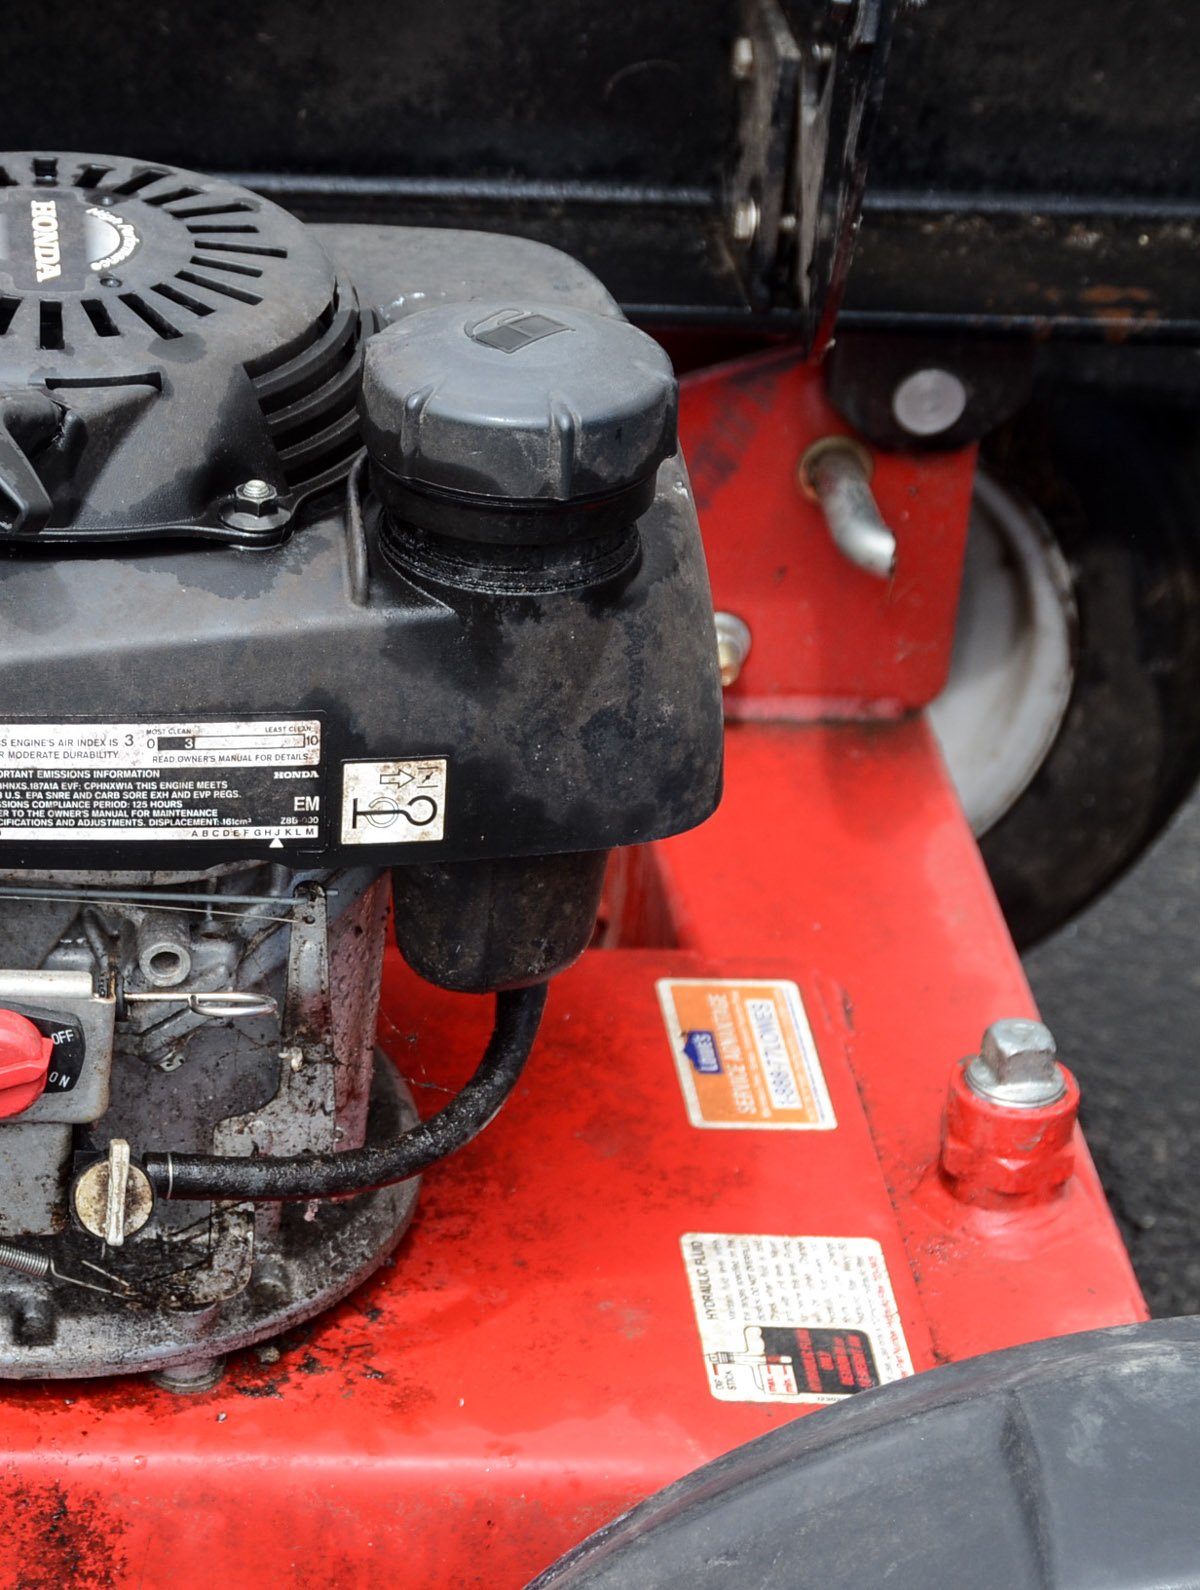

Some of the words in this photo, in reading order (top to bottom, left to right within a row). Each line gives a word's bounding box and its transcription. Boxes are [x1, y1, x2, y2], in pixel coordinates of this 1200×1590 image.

[30, 200, 62, 283] HONDA
[90, 224, 140, 271] Performance
[289, 725, 312, 733] CLEAN
[11, 738, 55, 747] ENGINE'S
[58, 738, 74, 747] AIR
[77, 738, 106, 747] INDEX
[109, 738, 119, 747] IS
[124, 734, 134, 747] 3
[184, 738, 194, 749] 3
[306, 735, 319, 746] 10
[8, 751, 60, 759] MODERATE
[63, 751, 120, 759] DURABILITY.
[152, 755, 175, 764] READ
[177, 755, 216, 763] OWNER'S
[218, 754, 252, 763] MANUAL
[255, 754, 272, 762] FOR
[37, 770, 91, 779] EMISSIONS
[93, 770, 160, 779] INFORMATION
[274, 771, 320, 779] HONDA
[61, 782, 81, 790] EVF:
[135, 782, 157, 790] THIS
[159, 781, 194, 789] ENGINE
[197, 781, 228, 789] MEETS
[5, 791, 23, 799] U.S.
[26, 791, 43, 799] EPA
[45, 791, 71, 799] SNRE
[73, 791, 92, 799] AND
[94, 791, 120, 799] CARB
[122, 791, 148, 799] SORE
[150, 791, 169, 799] EXH
[171, 791, 191, 799] AND
[193, 790, 211, 799] EVP
[213, 790, 242, 799] REGS.
[32, 801, 90, 809] COMPLIANCE
[93, 801, 130, 809] PERIOD:
[132, 801, 148, 809] 125
[150, 801, 183, 809] HOURS
[294, 796, 320, 811] EM
[56, 818, 75, 826] AND
[77, 818, 146, 826] ADJUSTMENTS.
[149, 818, 220, 826] DISPLACEMENT:
[51, 1029, 74, 1045] OFF
[49, 1071, 70, 1088] ON
[690, 1240, 708, 1265] FLUID
[697, 1267, 718, 1320] HYDRAULIC
